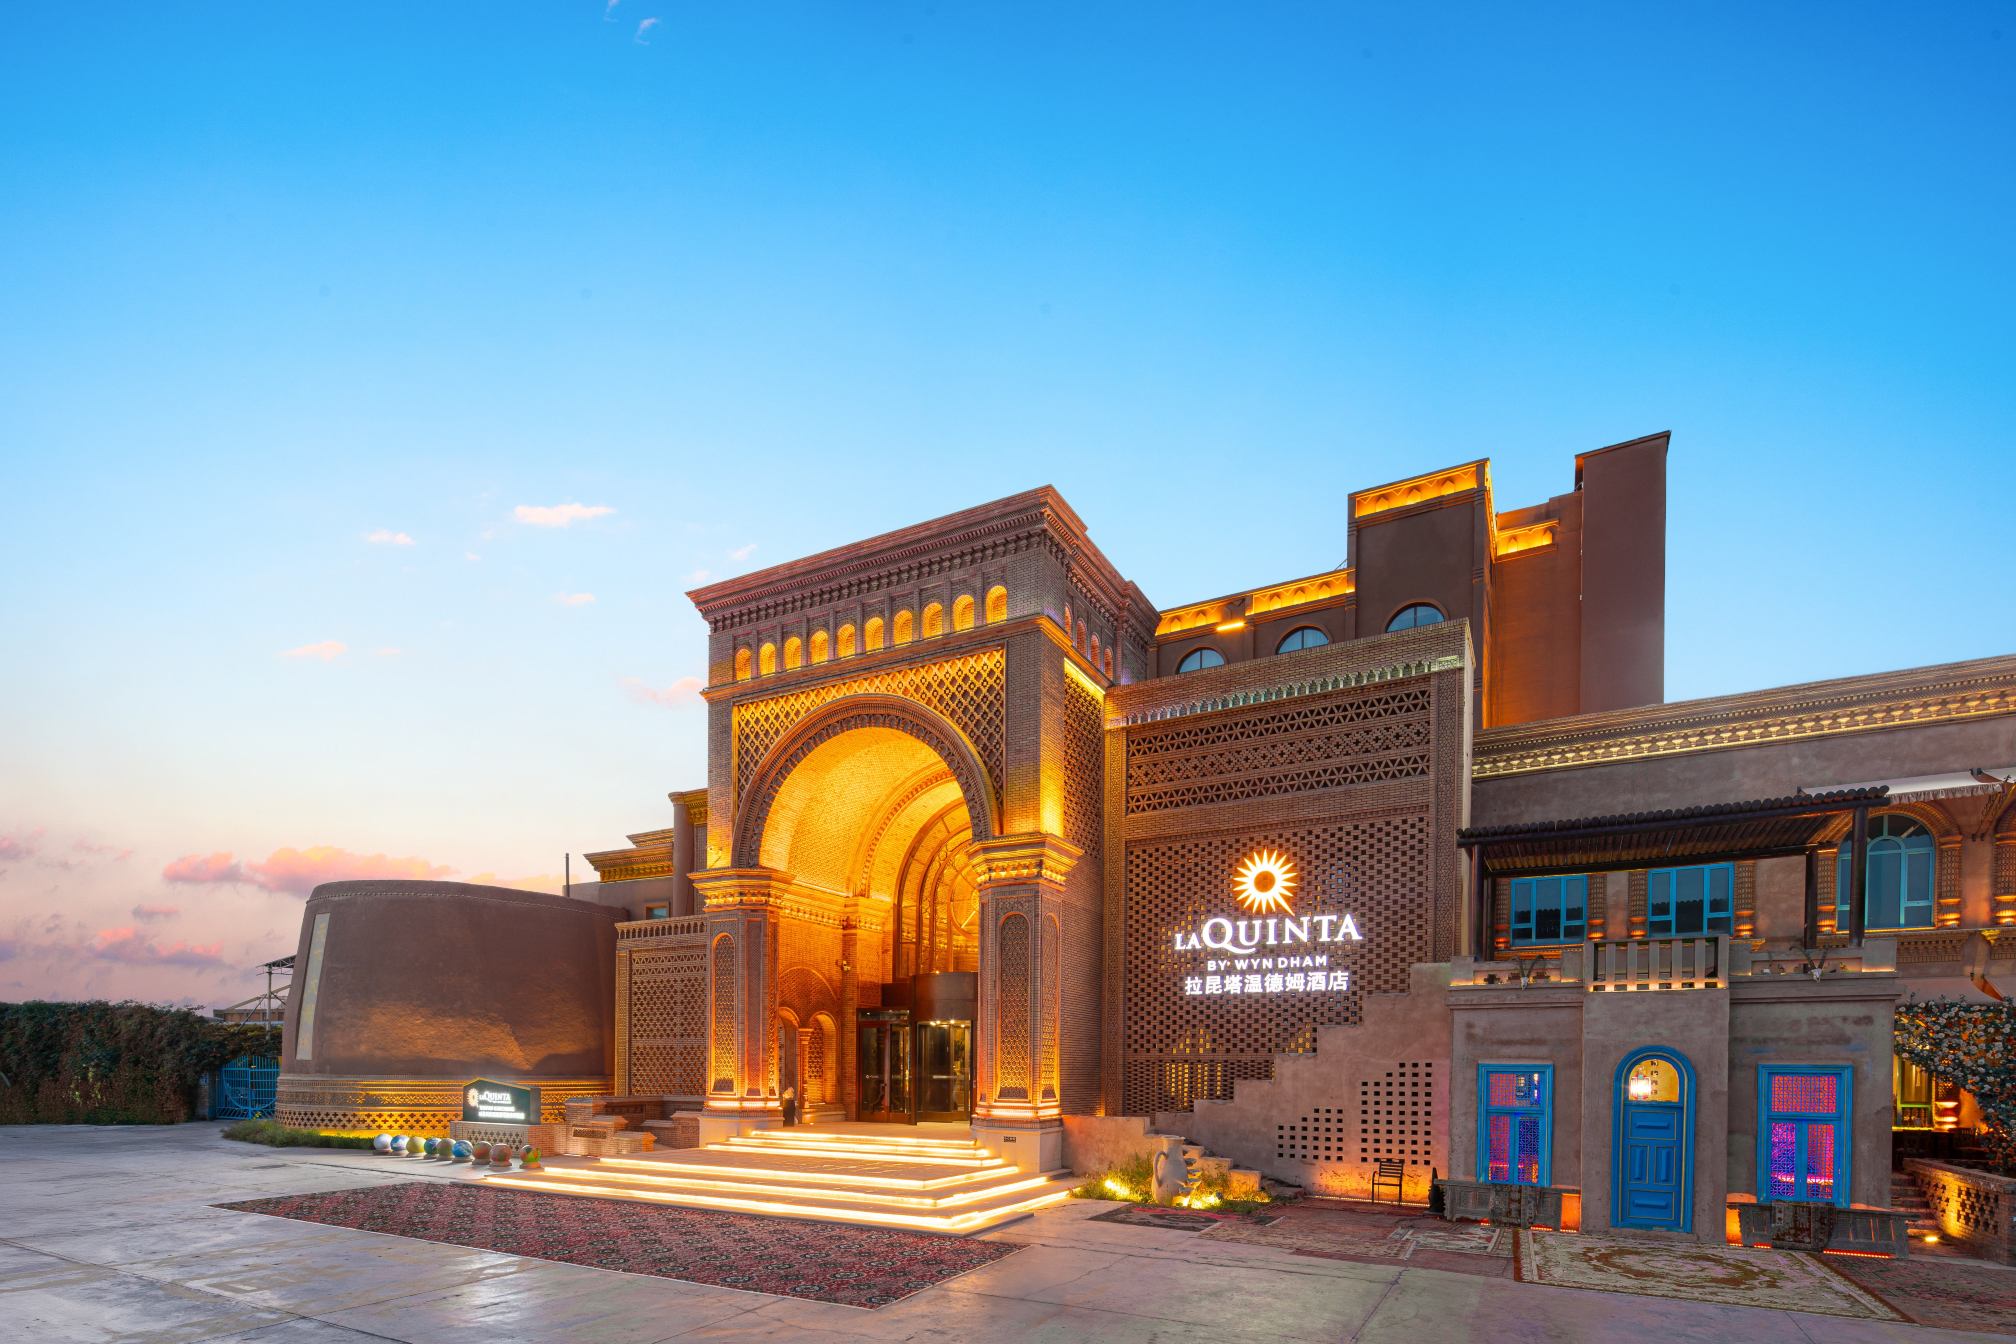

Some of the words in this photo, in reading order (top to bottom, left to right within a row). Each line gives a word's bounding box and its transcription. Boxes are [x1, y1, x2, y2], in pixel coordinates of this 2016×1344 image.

[1174, 933, 1202, 950] LA
[1202, 913, 1363, 954] QUINTA
[1207, 960, 1228, 971] BY
[1235, 955, 1328, 970] WYNDHAM
[1184, 971, 1349, 996] 拉昆塔温德姆酒店
